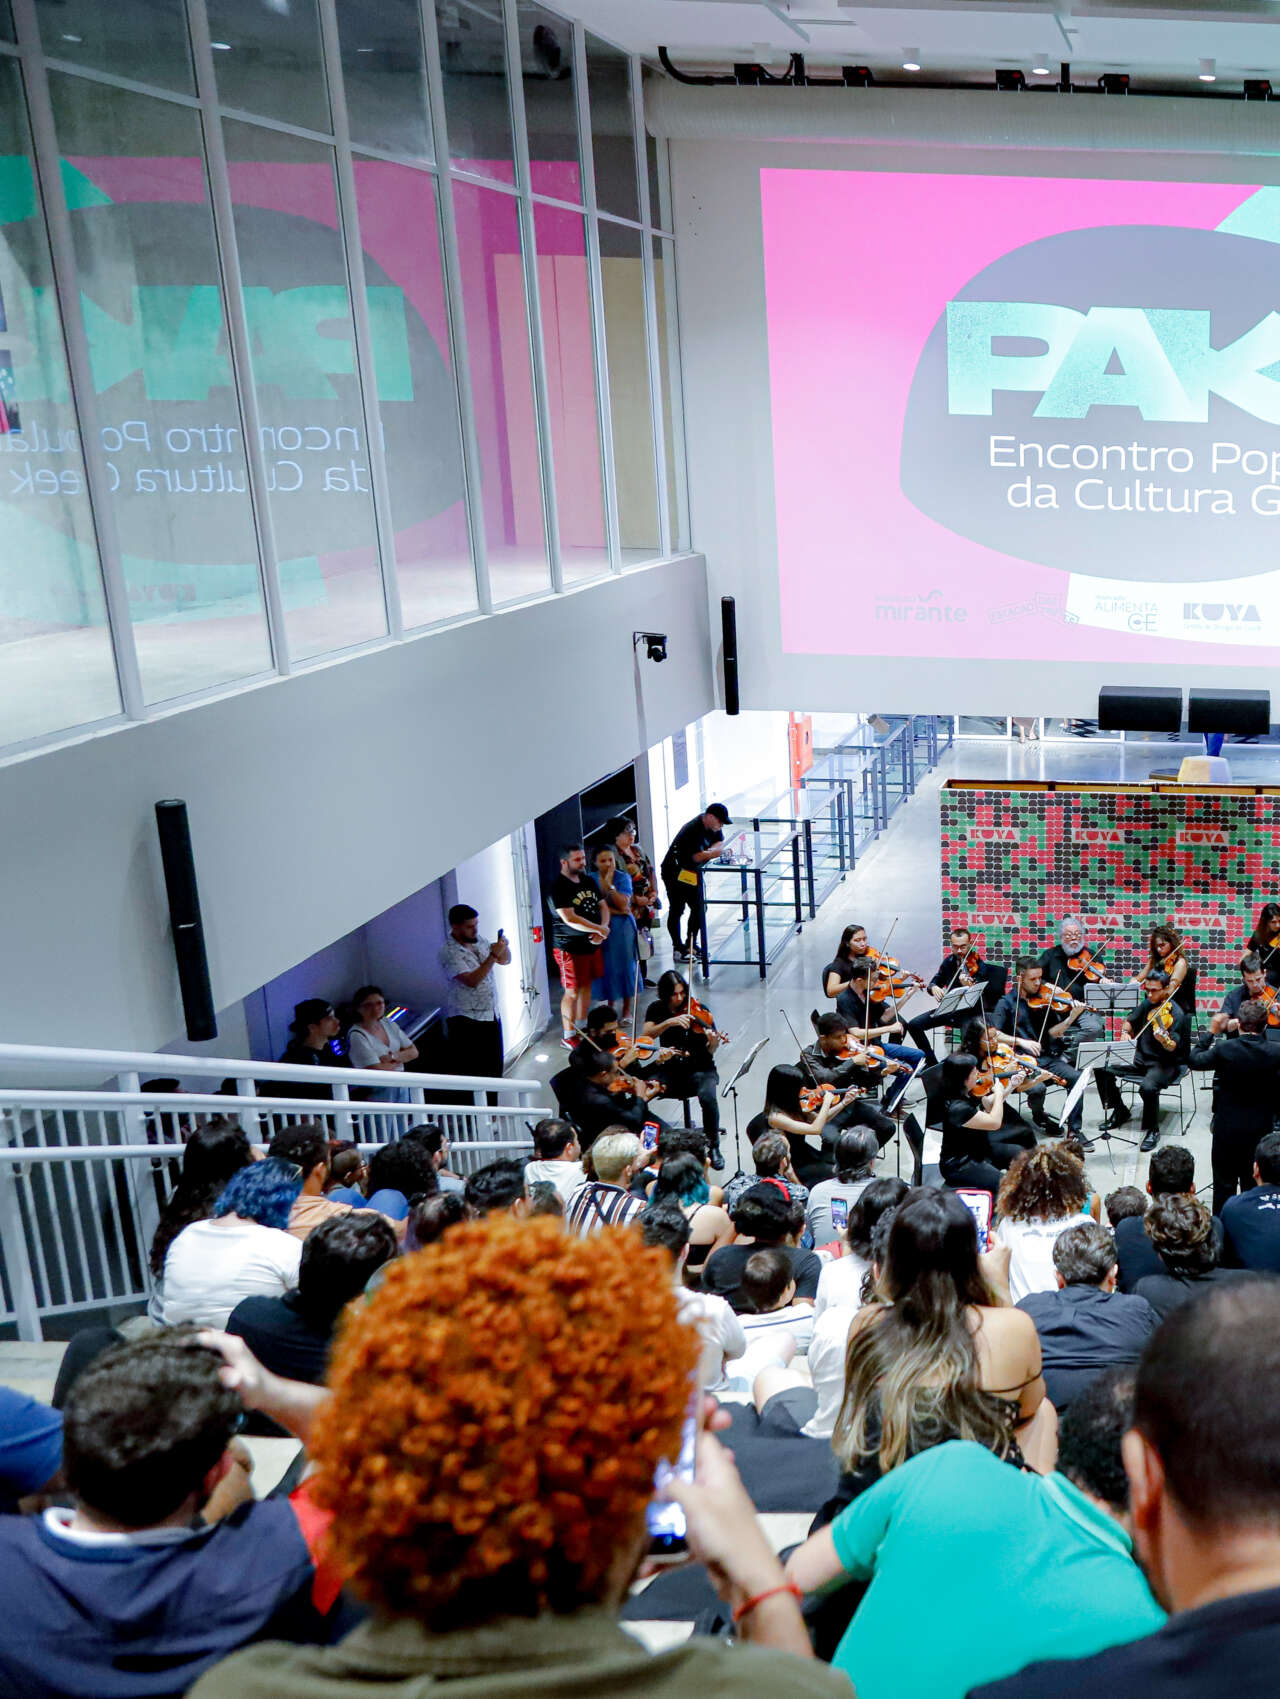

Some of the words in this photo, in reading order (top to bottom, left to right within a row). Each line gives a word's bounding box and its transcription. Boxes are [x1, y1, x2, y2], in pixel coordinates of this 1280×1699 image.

[989, 435, 1193, 473] Encontro
[1006, 475, 1060, 509] da
[1074, 478, 1237, 515] Cultura
[1183, 603, 1262, 621] KUYA
[970, 829, 1015, 839] KUYA
[1075, 831, 1120, 841] KUYA
[1180, 832, 1225, 842] KUYA
[971, 914, 1017, 925] KUYA
[1177, 917, 1222, 927] KUYA
